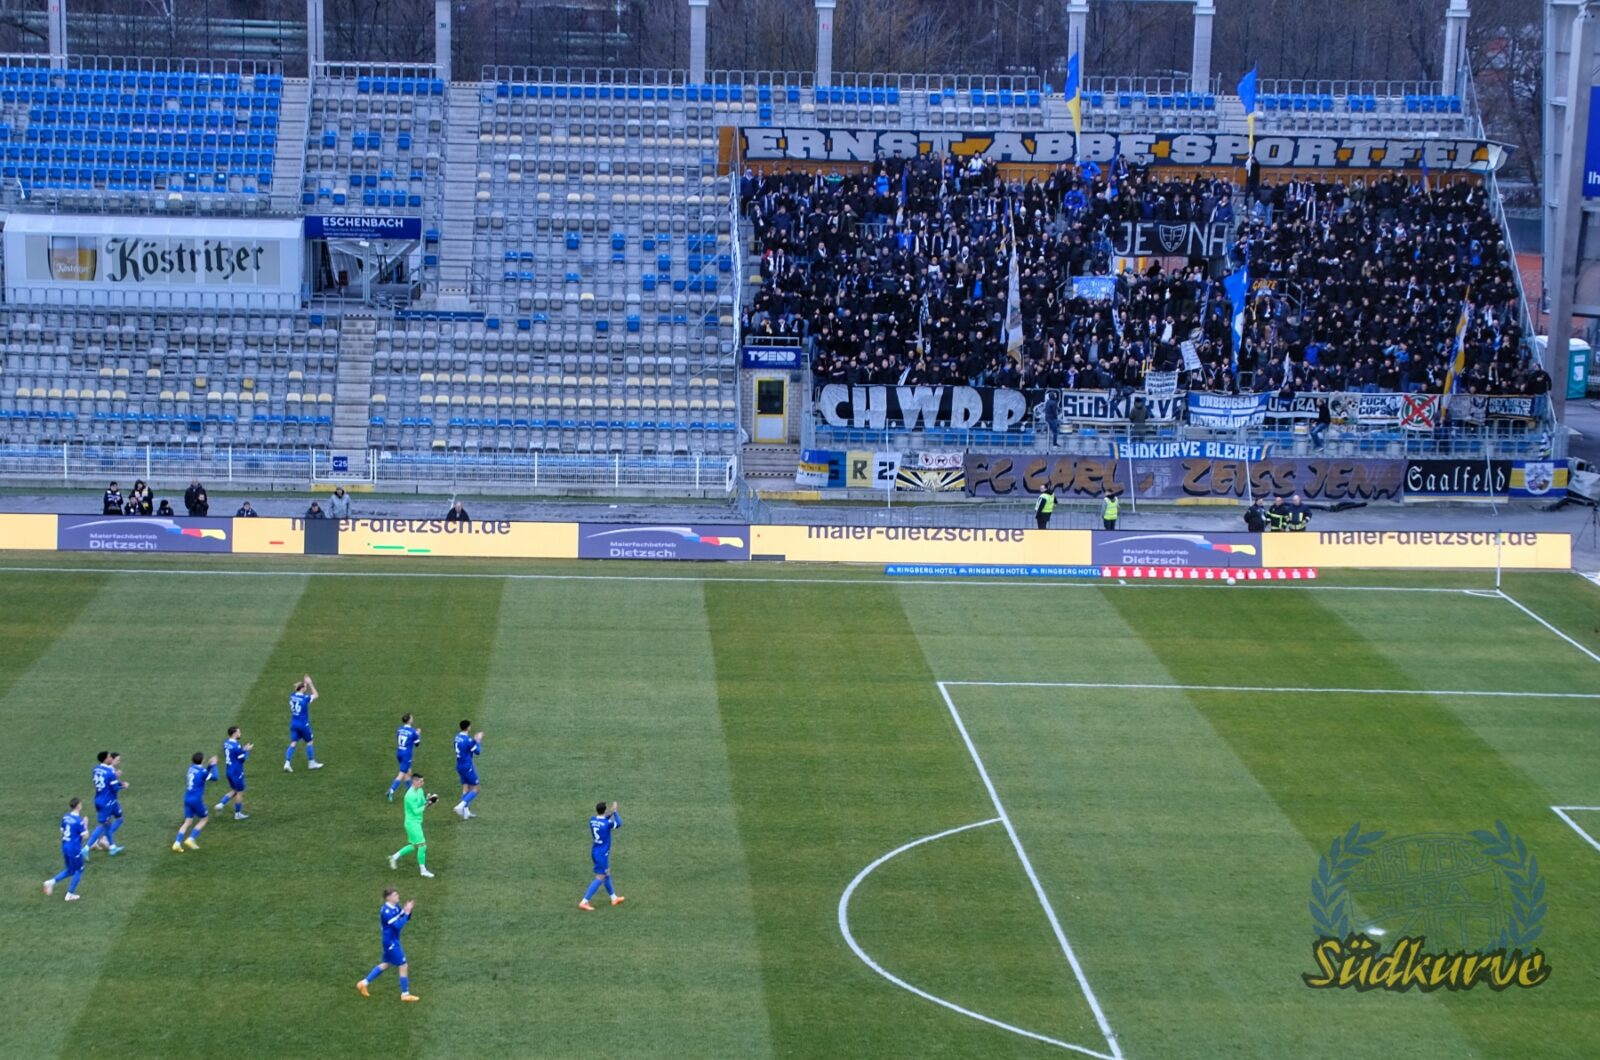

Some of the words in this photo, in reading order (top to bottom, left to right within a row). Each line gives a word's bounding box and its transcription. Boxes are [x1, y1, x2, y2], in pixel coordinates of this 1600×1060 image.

[743, 127, 963, 163] ERNST
[988, 131, 1157, 164] ABBE
[322, 216, 404, 228] ESCHENBACH
[105, 237, 264, 282] Köstritzer
[1360, 396, 1387, 406] FUCK
[1120, 441, 1200, 459] SÜDKURVE
[1206, 442, 1261, 460] BLEIBT
[1407, 466, 1506, 493] Saalfeld
[896, 566, 934, 574] RINGBERG
[934, 567, 957, 575] HOTEL
[968, 566, 1005, 575] RINGBERG
[1005, 567, 1029, 575] HOTEL
[1040, 567, 1078, 575] RINGBERG
[1078, 568, 1101, 576] HOTEL
